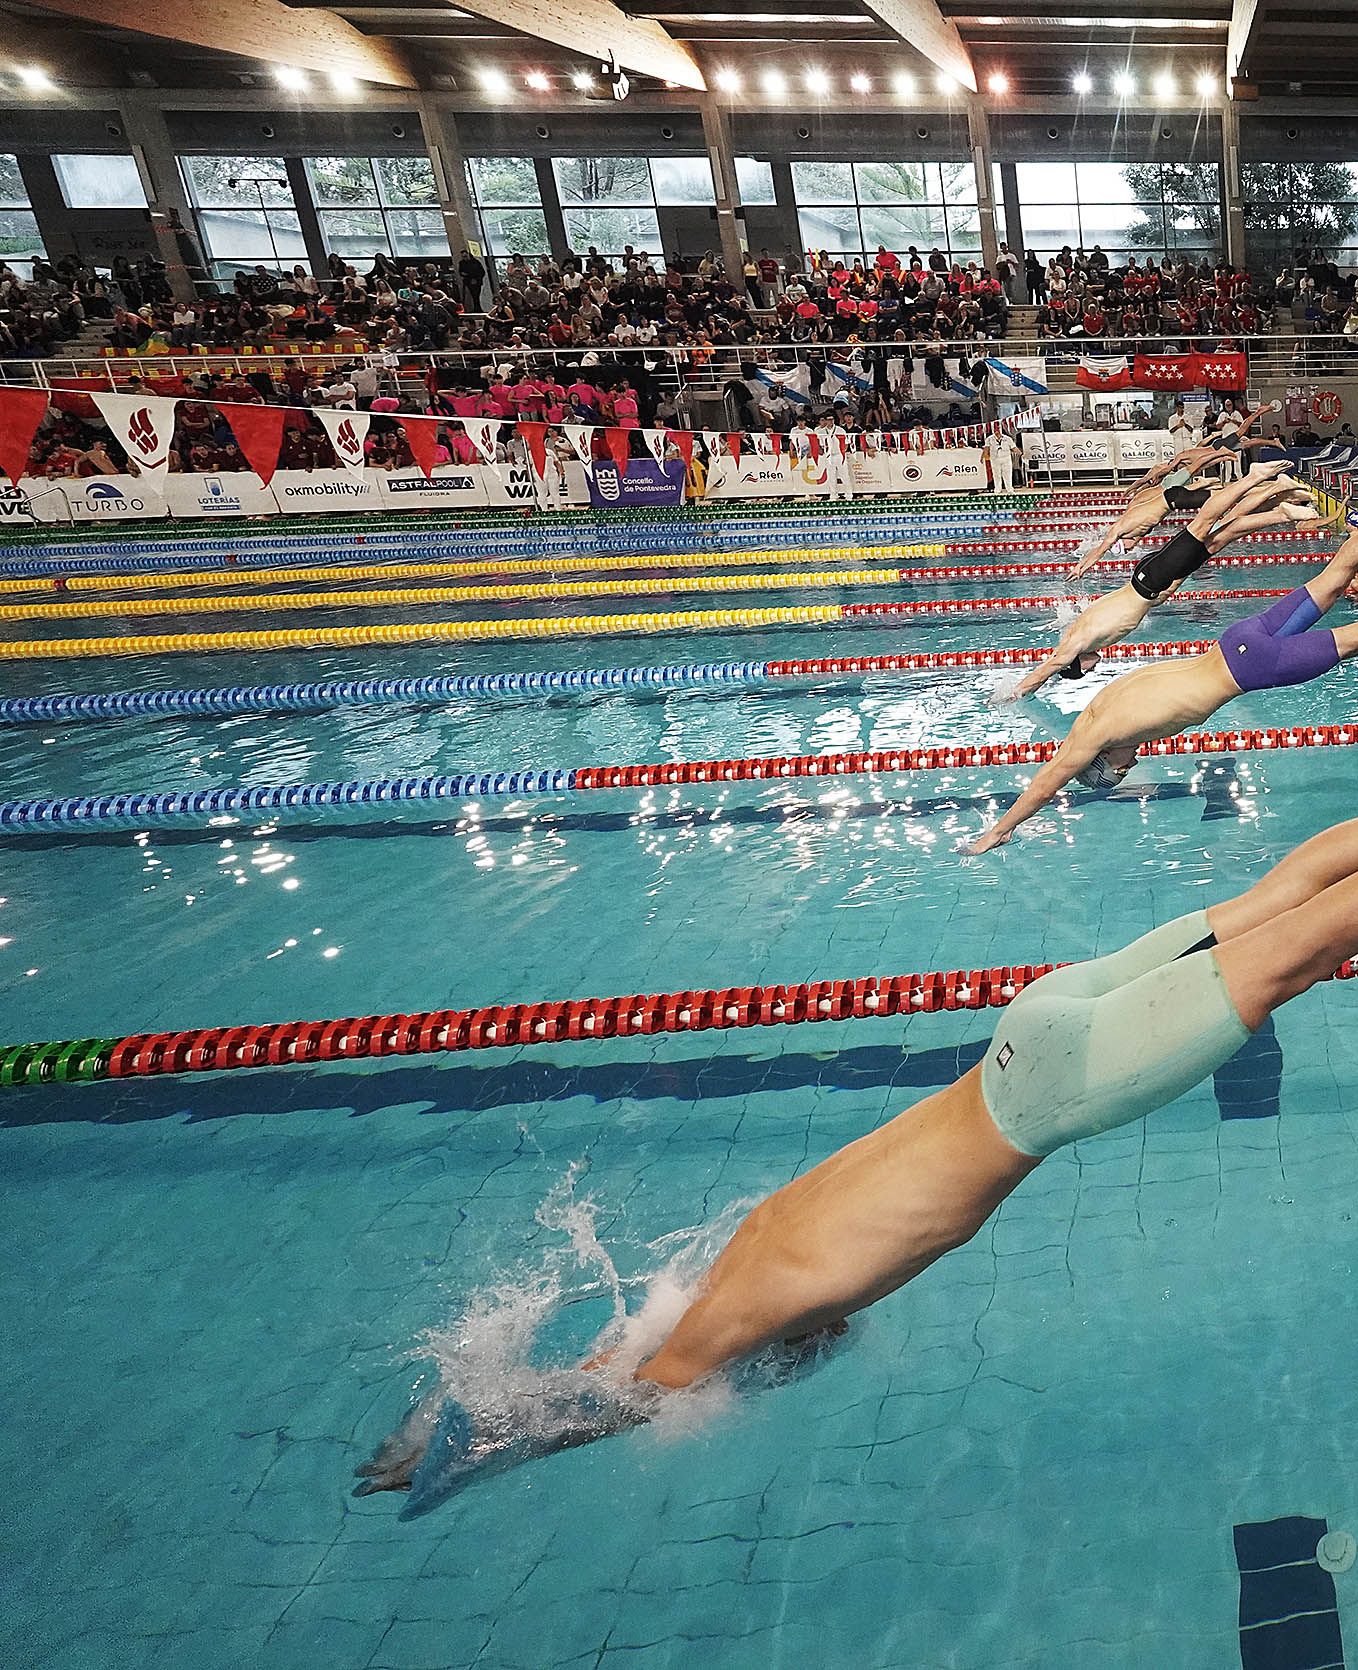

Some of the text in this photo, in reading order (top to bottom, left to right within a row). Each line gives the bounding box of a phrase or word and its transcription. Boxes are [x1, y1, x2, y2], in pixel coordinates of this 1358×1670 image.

[1122, 449, 1156, 458] GALAICO
[622, 477, 653, 485] Concello
[635, 485, 676, 493] Pontevedra
[71, 499, 144, 512] TURBO
